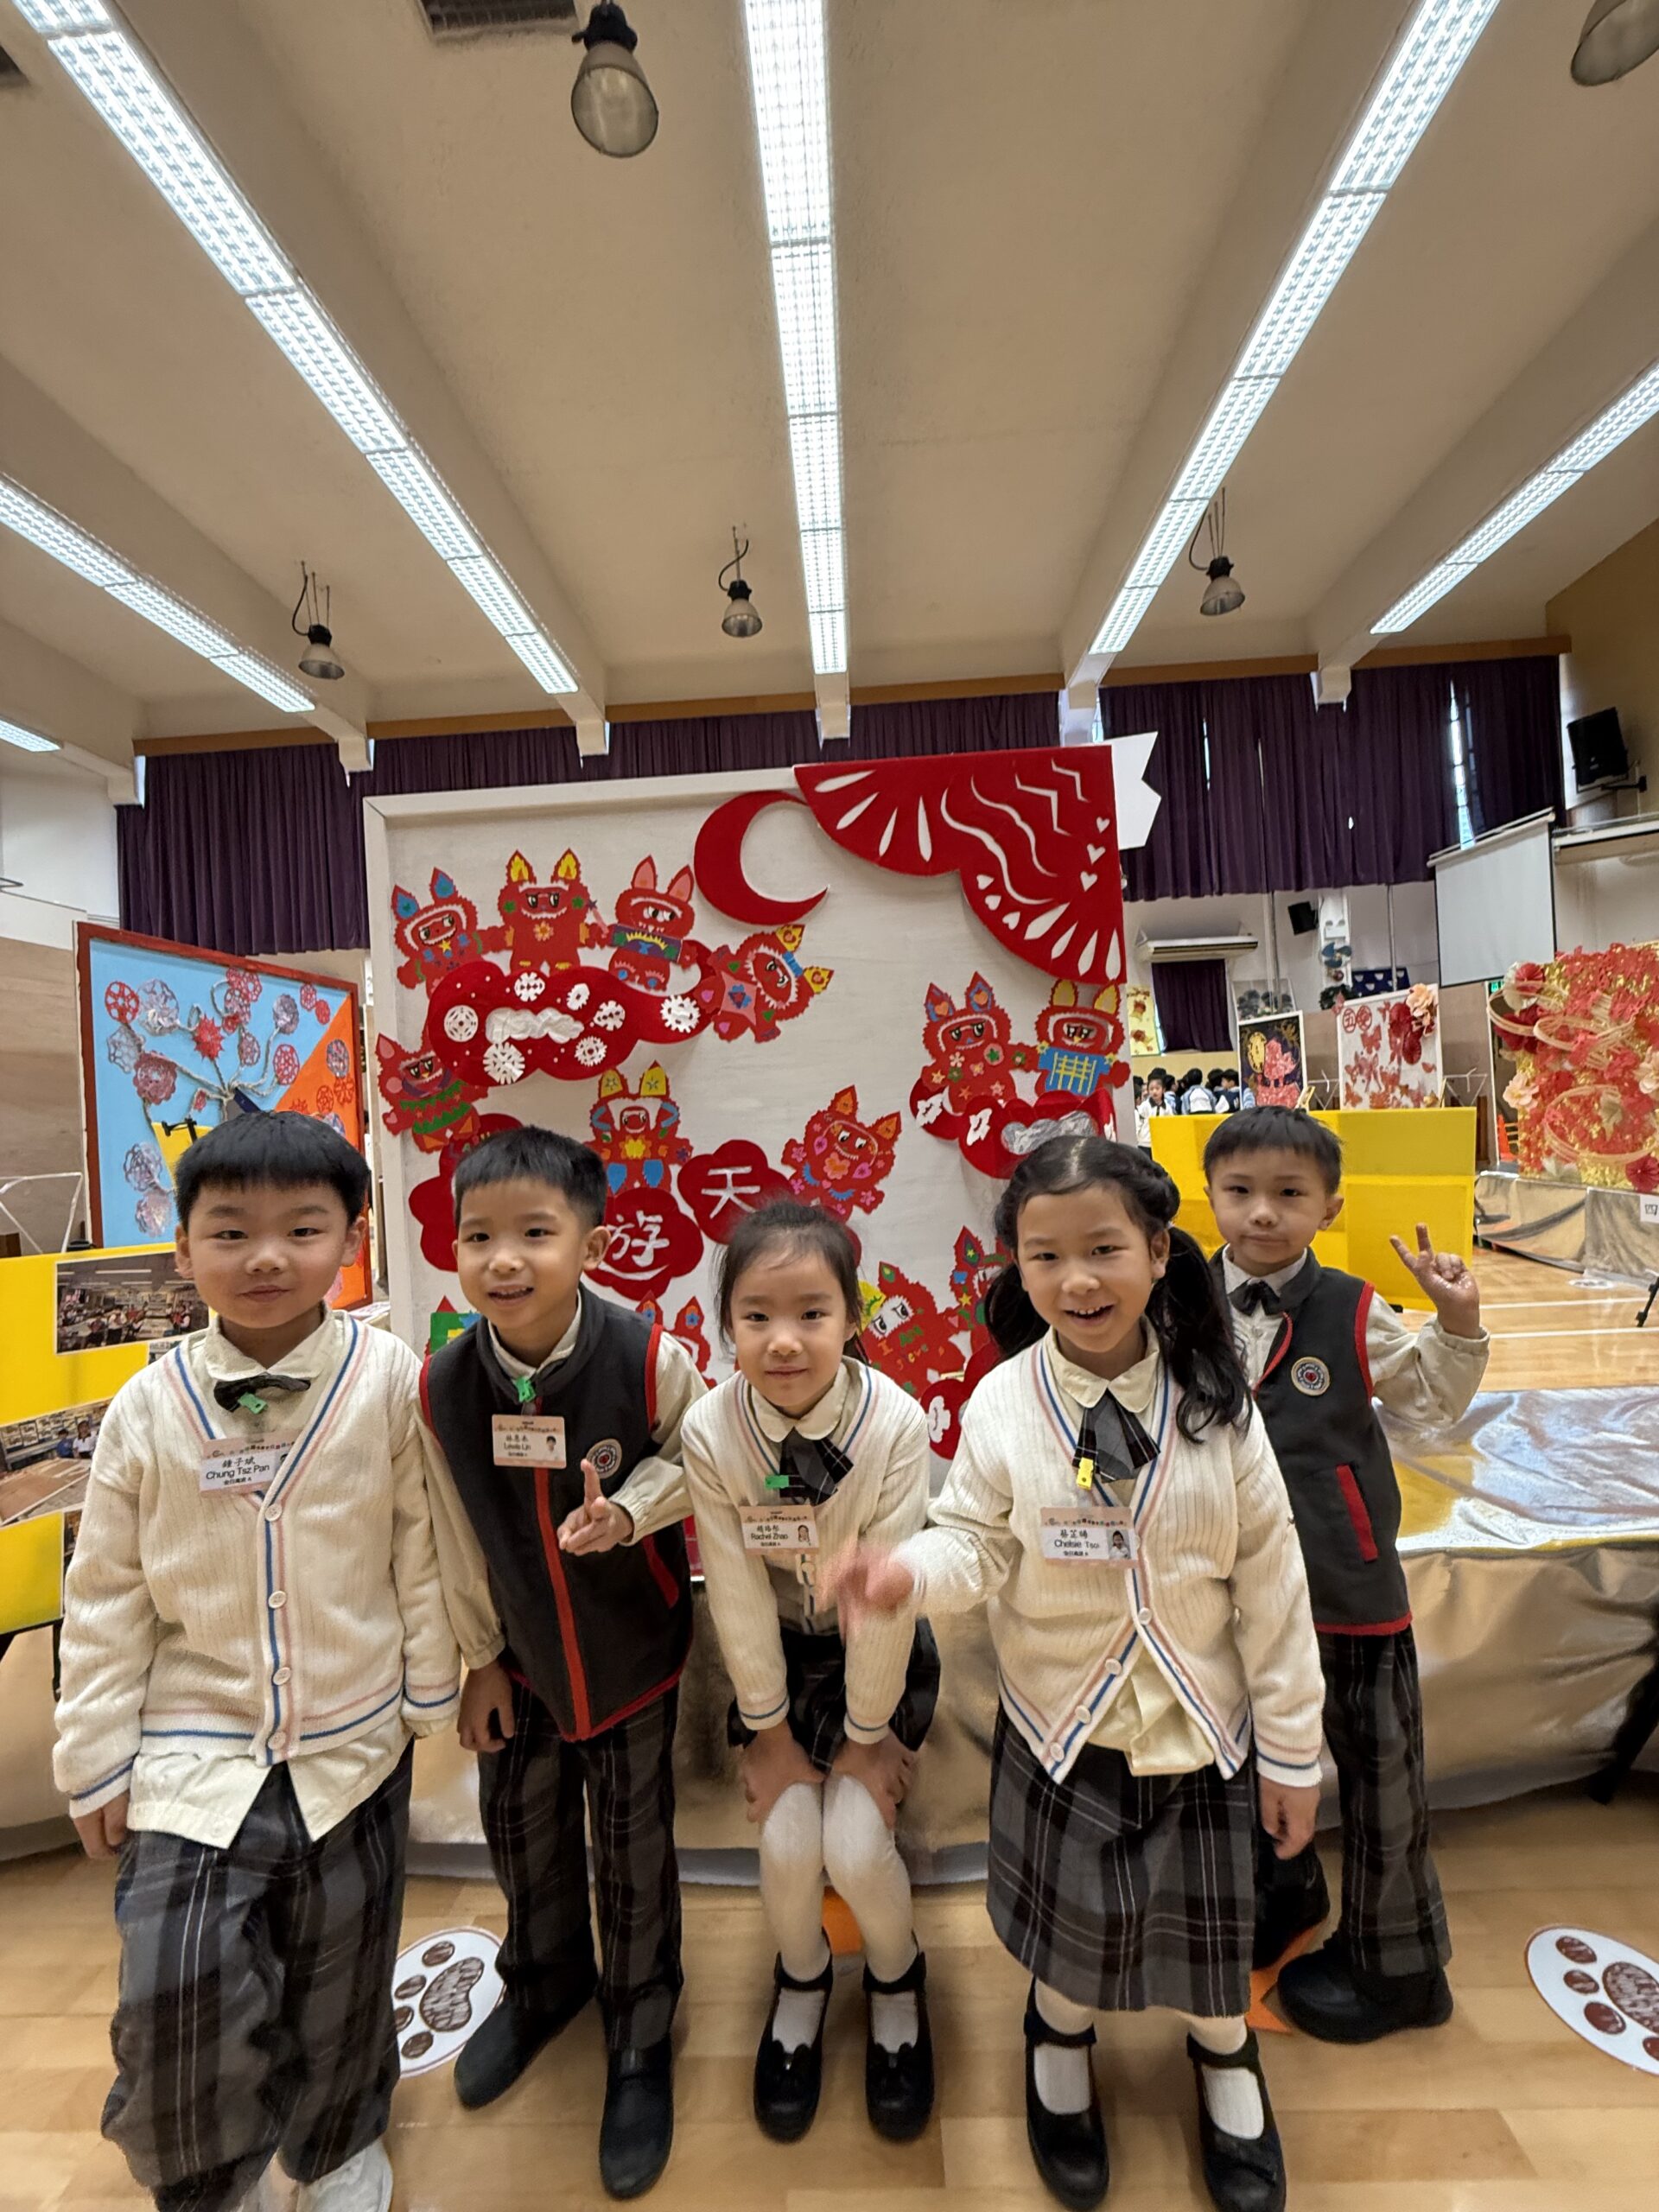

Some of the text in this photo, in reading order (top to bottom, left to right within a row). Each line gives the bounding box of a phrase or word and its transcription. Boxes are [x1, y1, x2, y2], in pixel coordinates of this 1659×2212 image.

[701, 1166, 760, 1218] 天
[206, 1465, 270, 1479] Chung Tsz Pan
